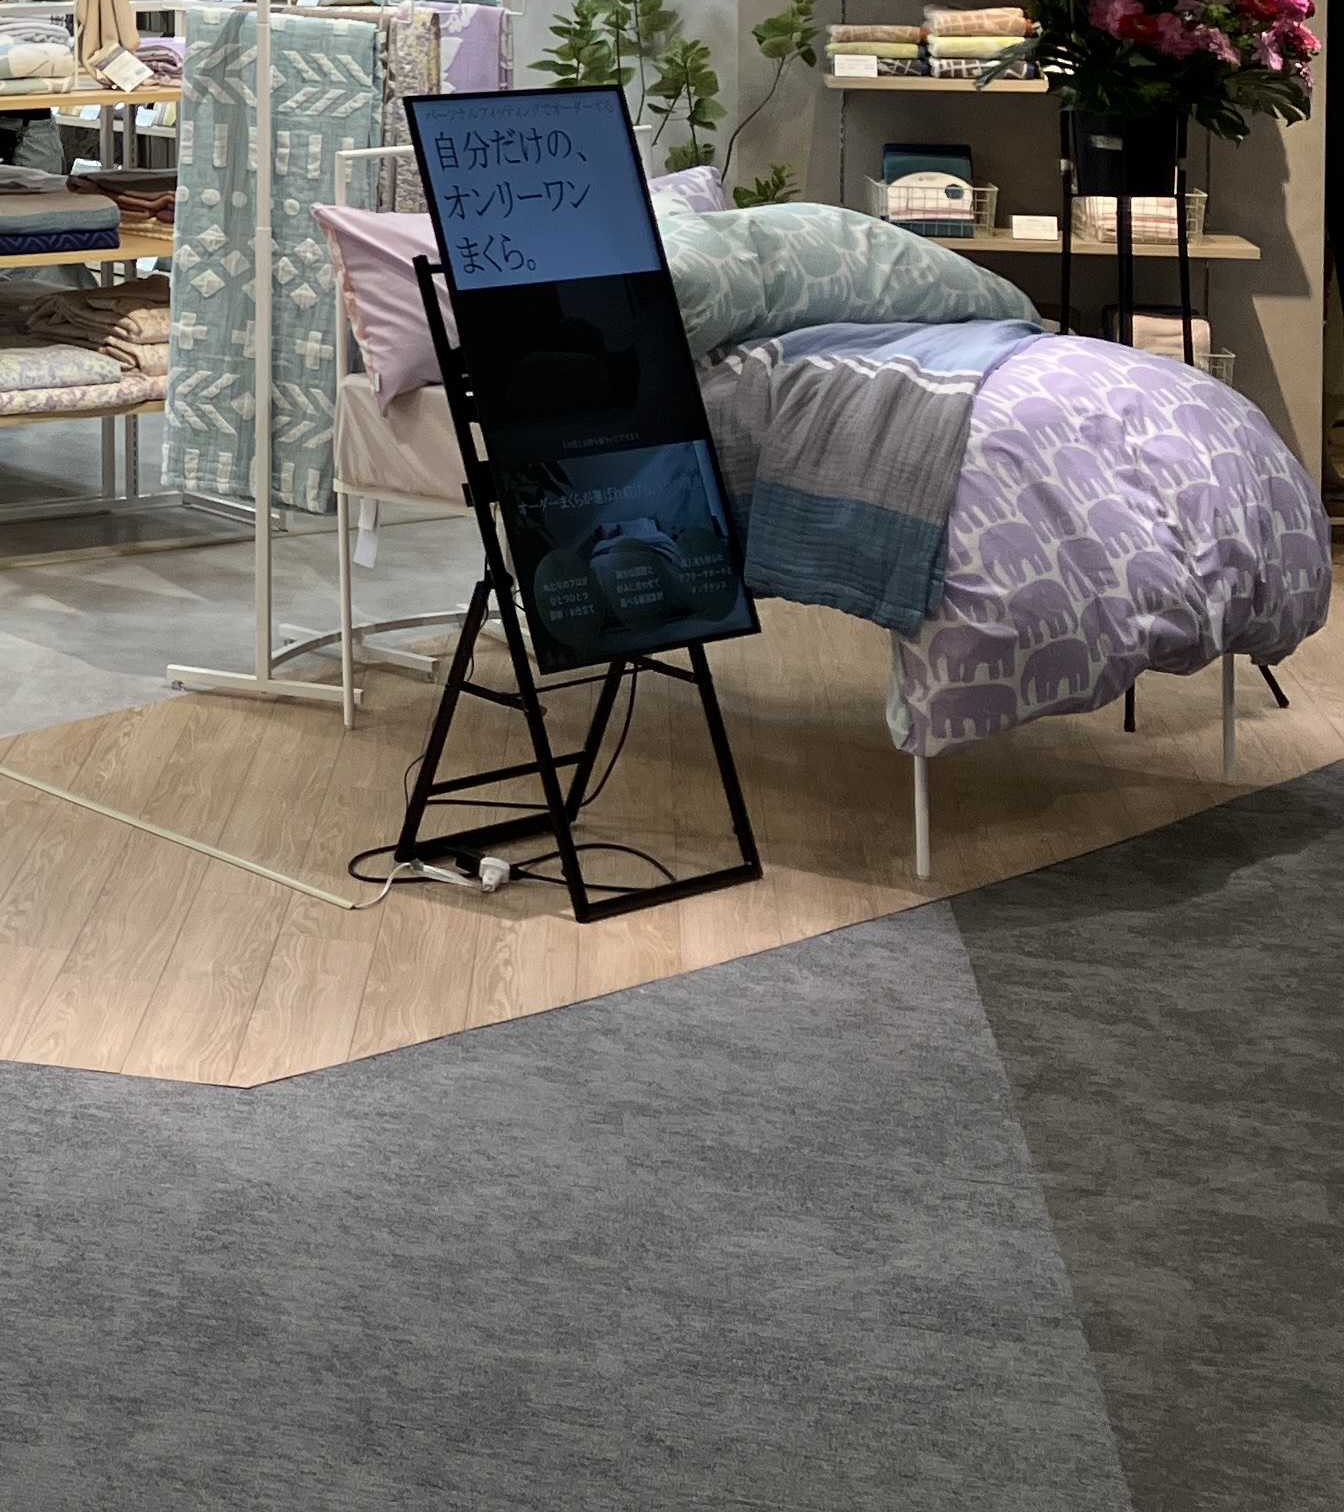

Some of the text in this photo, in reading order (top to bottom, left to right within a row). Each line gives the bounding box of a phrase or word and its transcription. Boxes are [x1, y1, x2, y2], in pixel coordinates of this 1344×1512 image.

[434, 127, 589, 172] 自分だけの、
[443, 179, 593, 221] オンリーワン
[454, 233, 538, 275] まくら。
